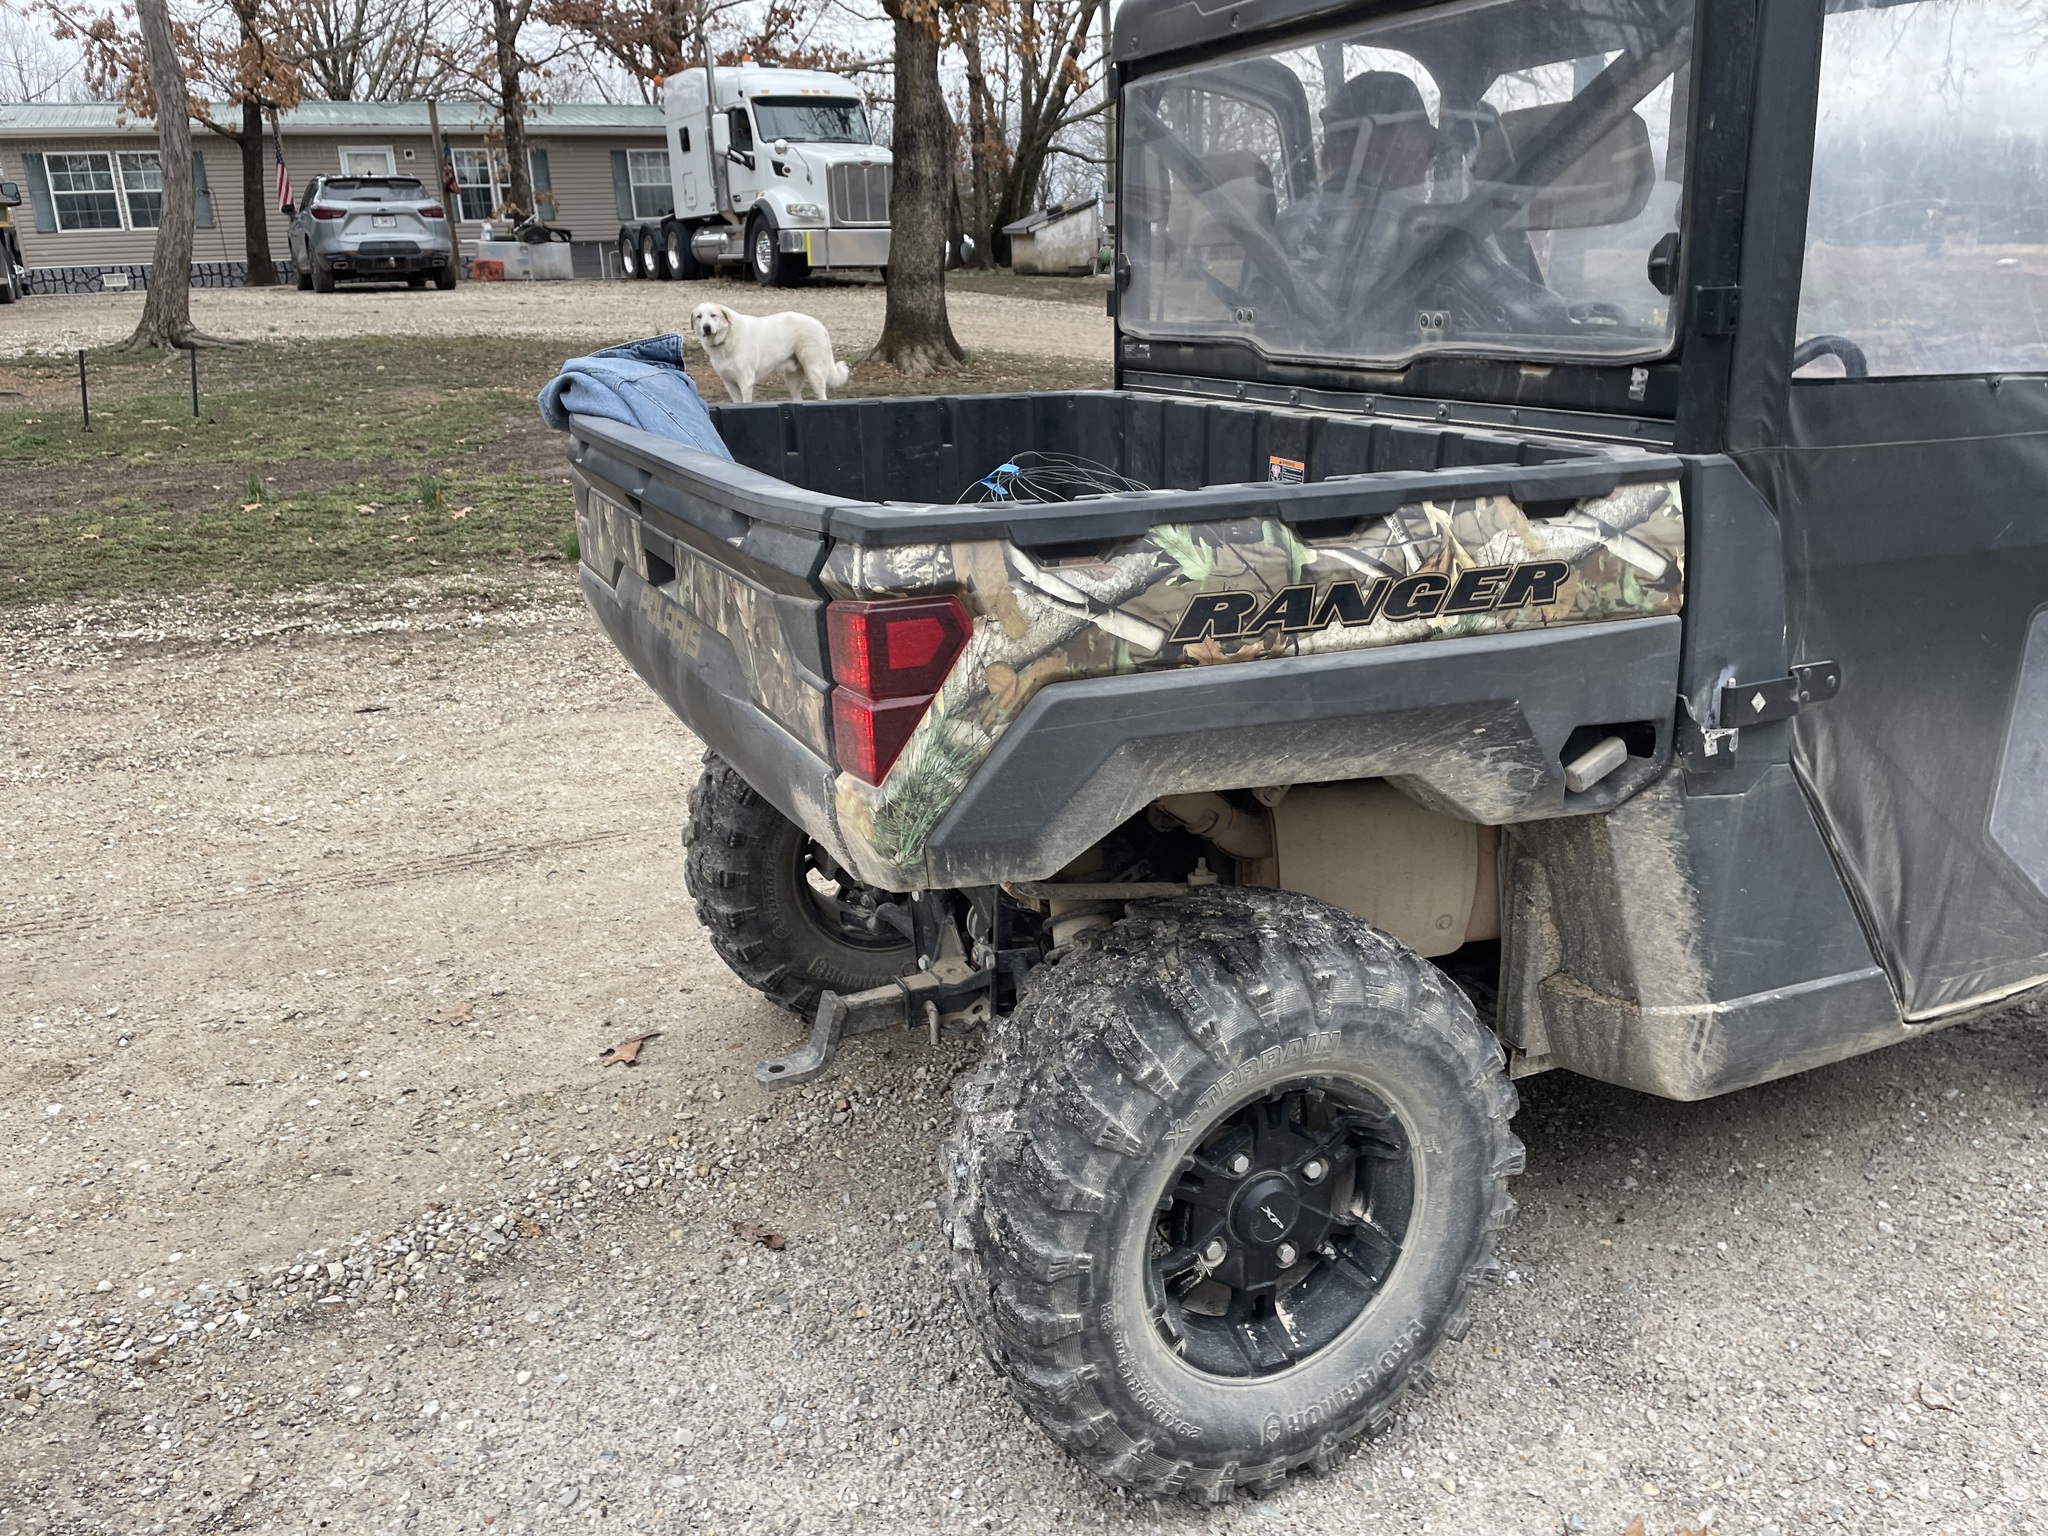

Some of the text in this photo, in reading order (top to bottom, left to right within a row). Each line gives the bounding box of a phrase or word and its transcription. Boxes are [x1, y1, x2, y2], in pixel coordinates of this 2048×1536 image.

[639, 586, 703, 660] POLARIS
[1167, 559, 1571, 644] RANGER
[1162, 1031, 1341, 1151] X-TERRAIN
